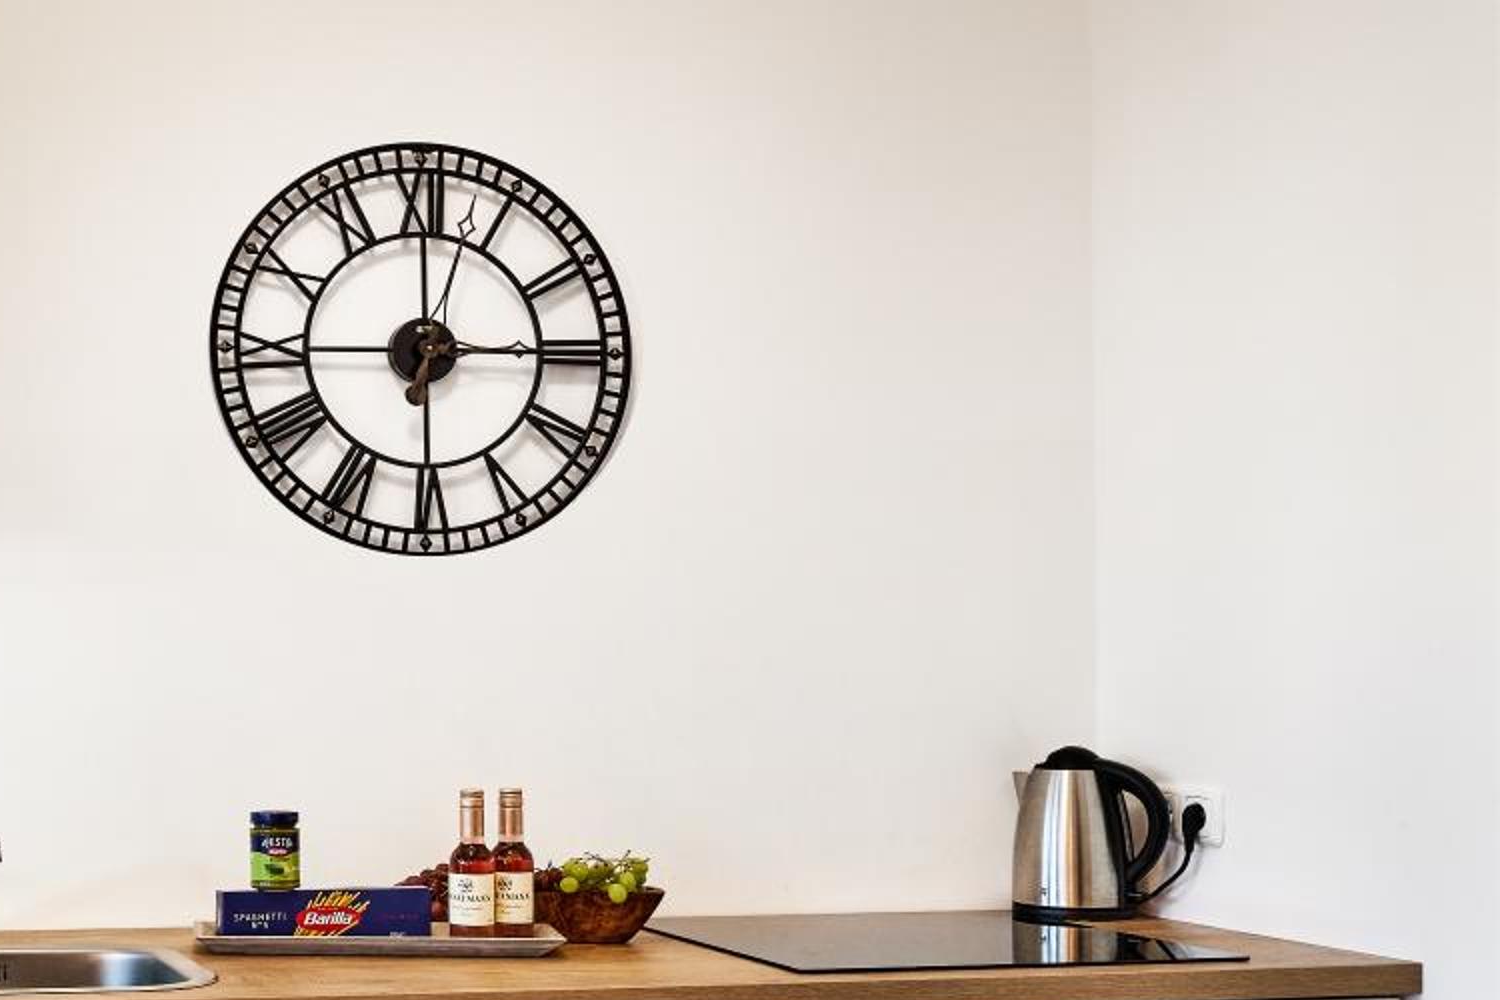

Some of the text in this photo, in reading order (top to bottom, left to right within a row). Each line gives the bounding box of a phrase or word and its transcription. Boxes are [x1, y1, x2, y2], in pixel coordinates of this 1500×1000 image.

[314, 184, 377, 256] XI
[394, 171, 445, 236] XII
[255, 247, 327, 304] X
[238, 331, 307, 369] IX
[540, 339, 602, 366] III
[320, 444, 377, 517] VII
[414, 466, 449, 532] VI
[482, 451, 531, 514] V
[303, 911, 353, 925] Barilla
